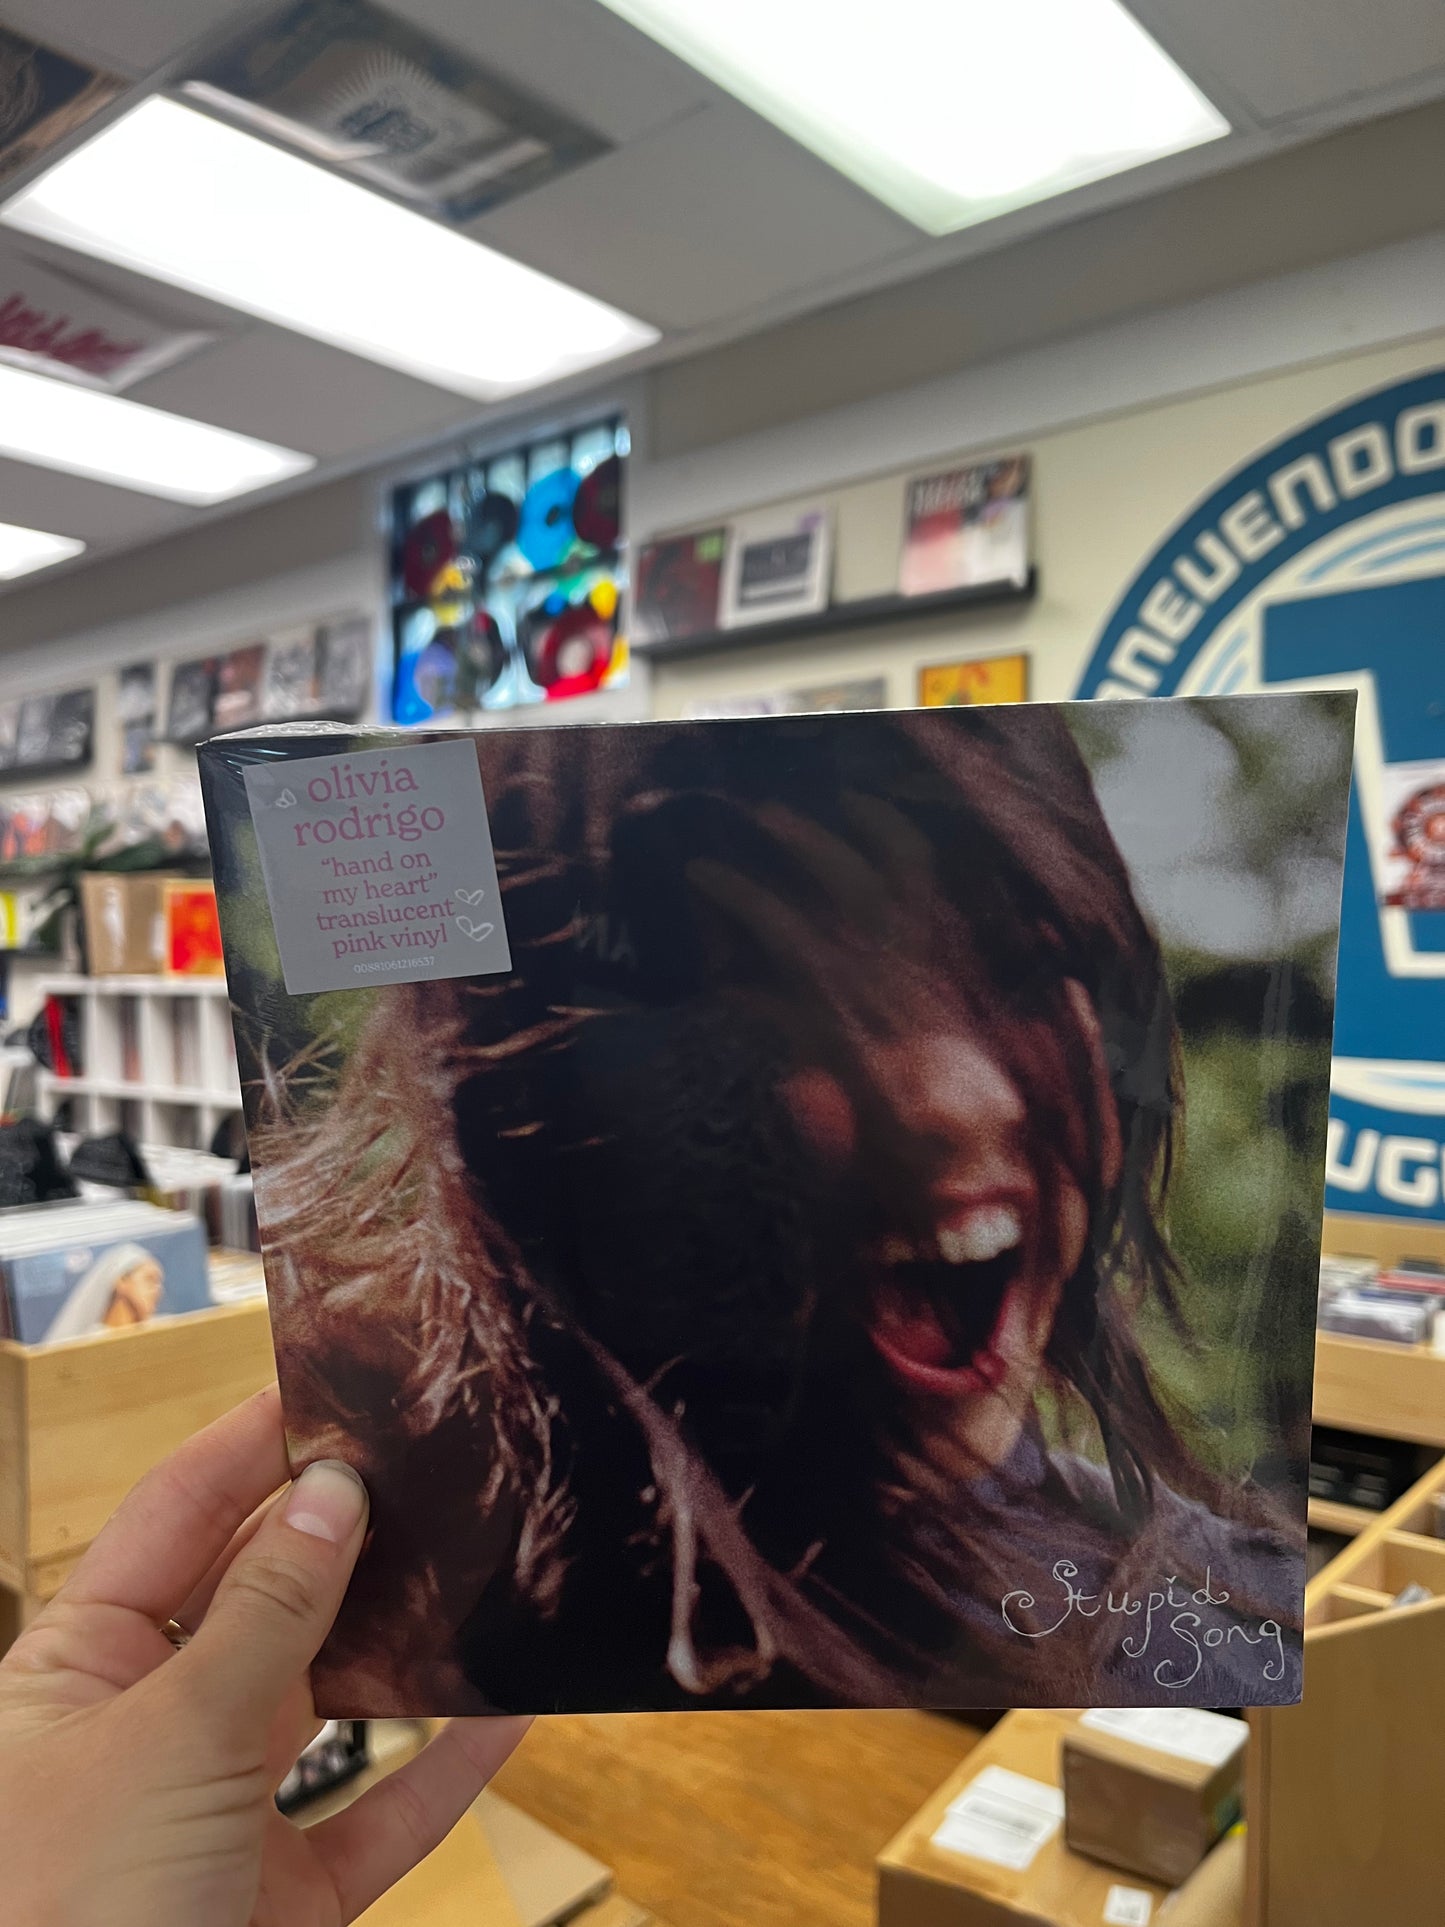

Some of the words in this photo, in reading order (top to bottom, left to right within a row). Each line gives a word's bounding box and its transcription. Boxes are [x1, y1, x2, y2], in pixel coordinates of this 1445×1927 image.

[307, 760, 419, 802] olivia
[294, 803, 445, 846] rodrigo
[321, 850, 393, 877] “hand
[400, 852, 432, 869] on
[322, 885, 358, 906] my
[363, 872, 438, 899] heart”
[316, 899, 455, 931] translucent
[332, 931, 385, 958] pink
[392, 923, 448, 949] vinyl
[1001, 1559, 1230, 1658] Stupid
[1153, 1612, 1286, 1689] Song
